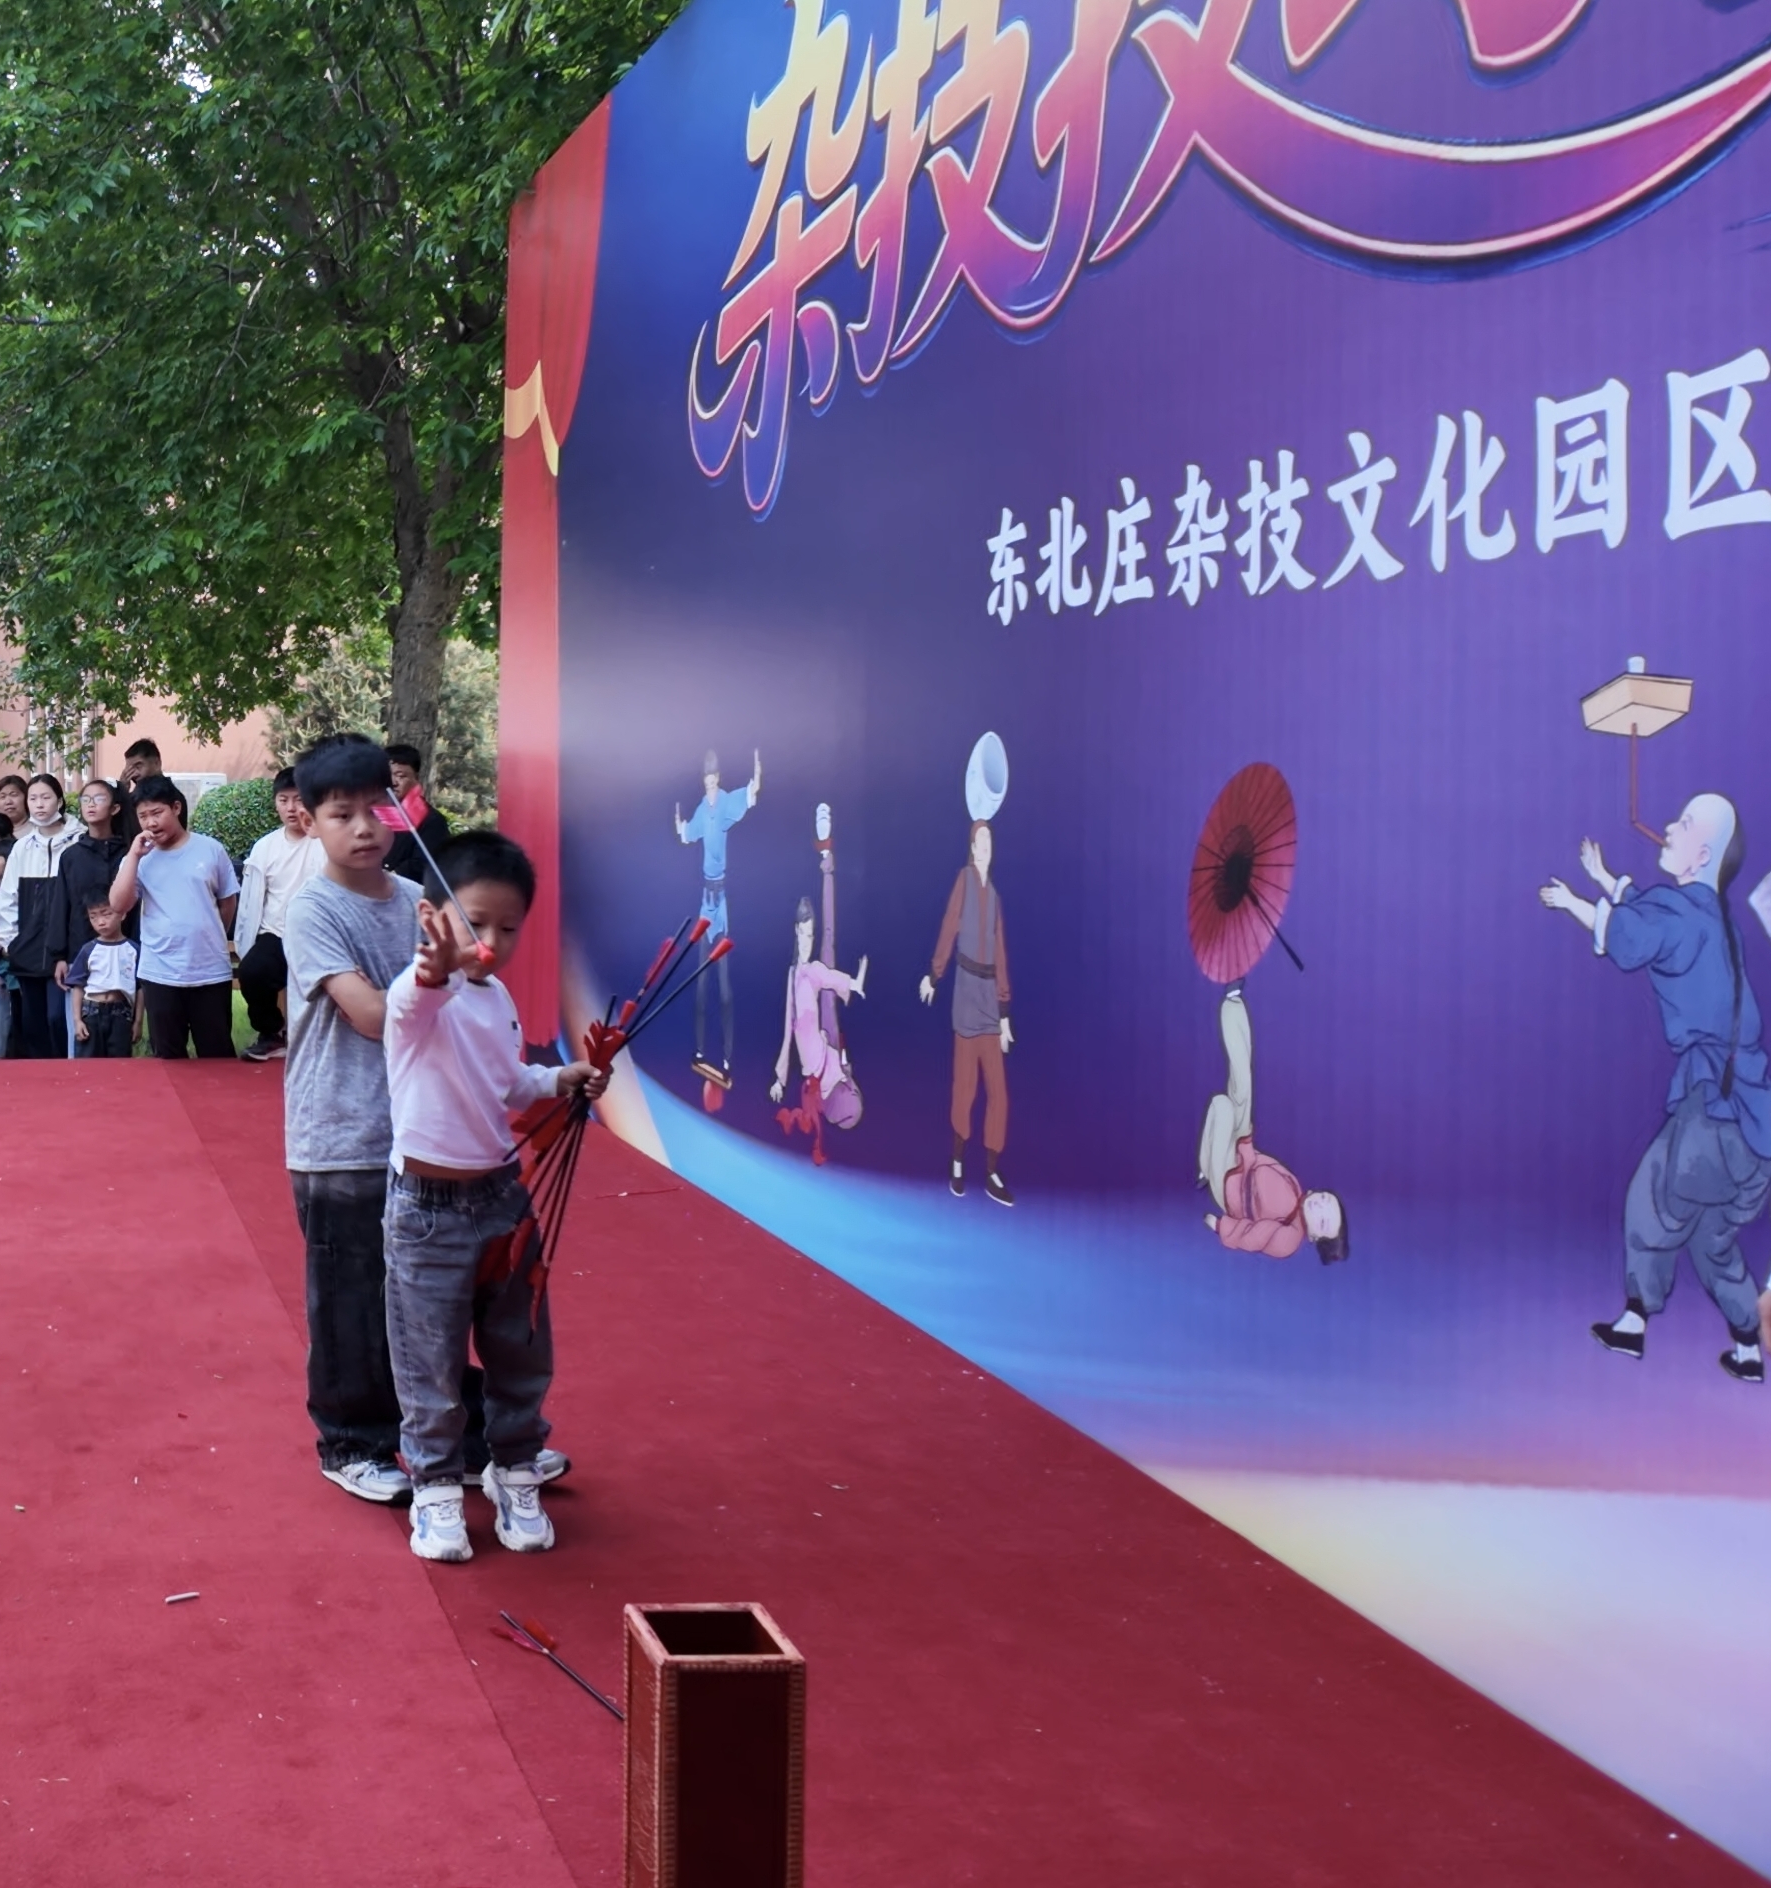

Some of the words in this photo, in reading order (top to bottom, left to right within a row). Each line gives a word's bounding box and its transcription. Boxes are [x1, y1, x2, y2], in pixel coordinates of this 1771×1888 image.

[986, 349, 1771, 626] 东北庄杂技文化园区
